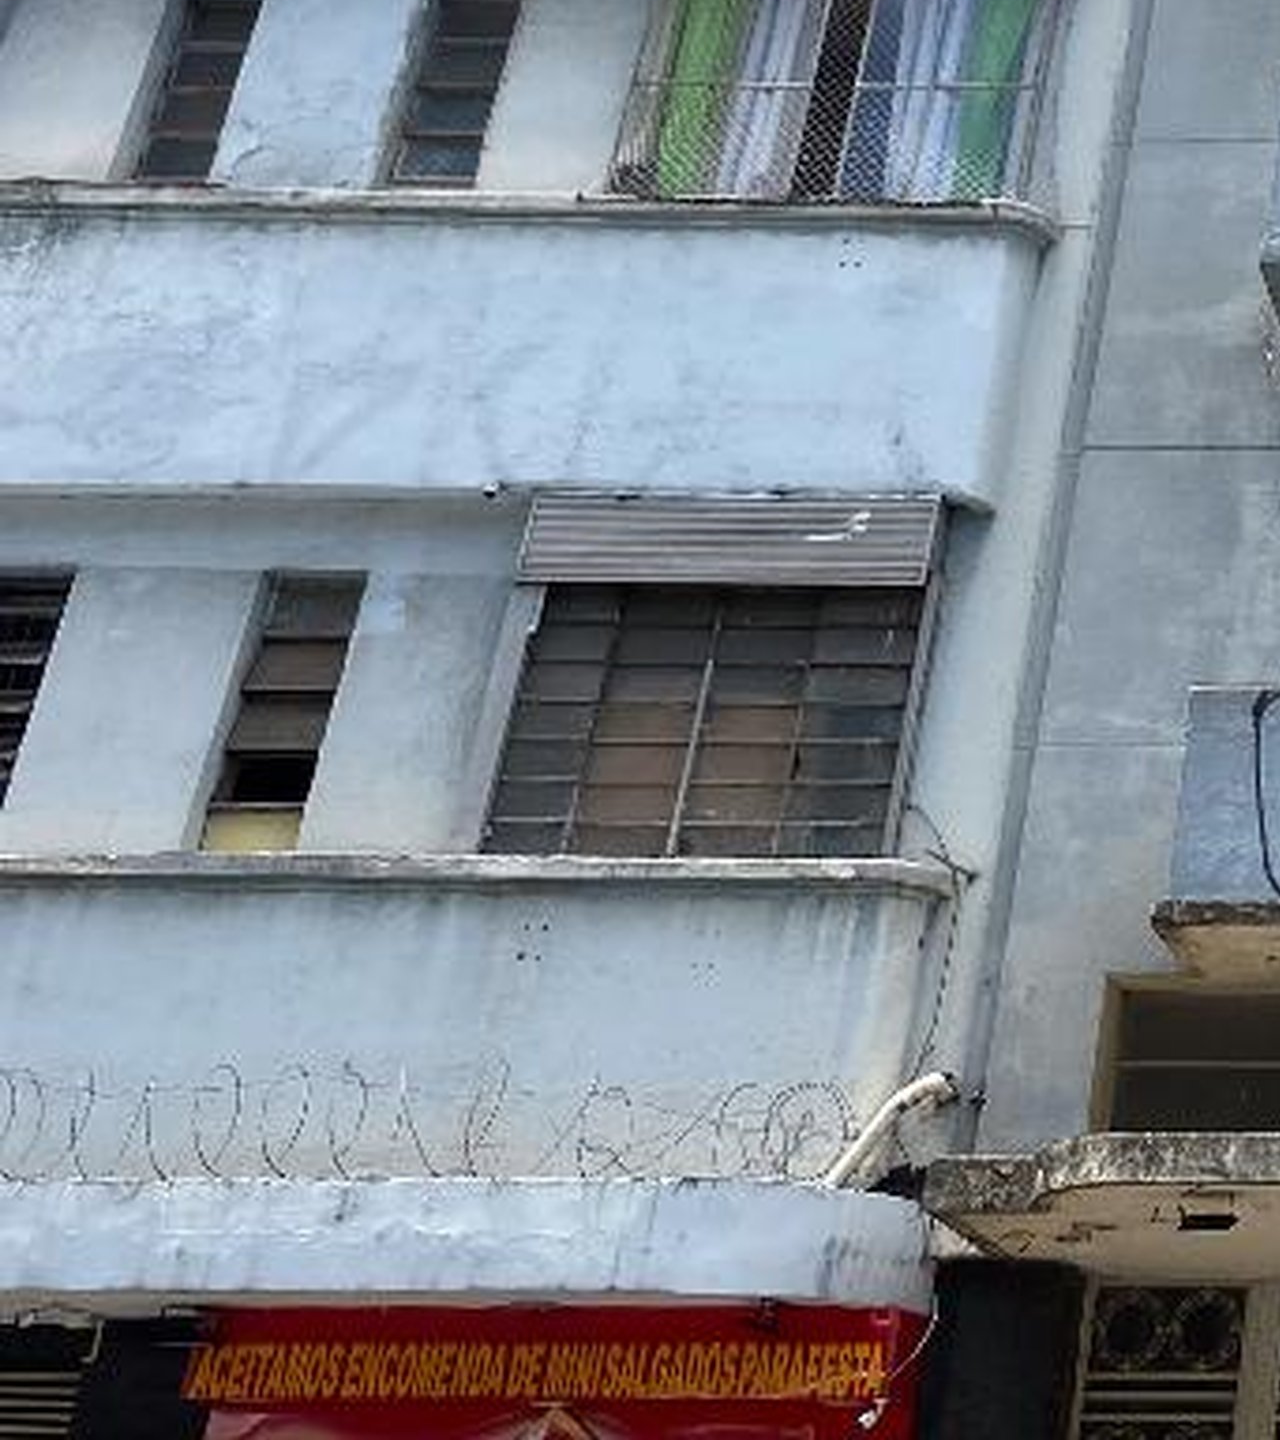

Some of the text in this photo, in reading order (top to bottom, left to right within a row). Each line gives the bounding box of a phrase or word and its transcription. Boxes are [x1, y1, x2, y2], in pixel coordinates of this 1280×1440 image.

[191, 1343, 341, 1398] ACEITAMOS
[341, 1343, 504, 1398] ENCOMENDA
[506, 1343, 543, 1397] DE
